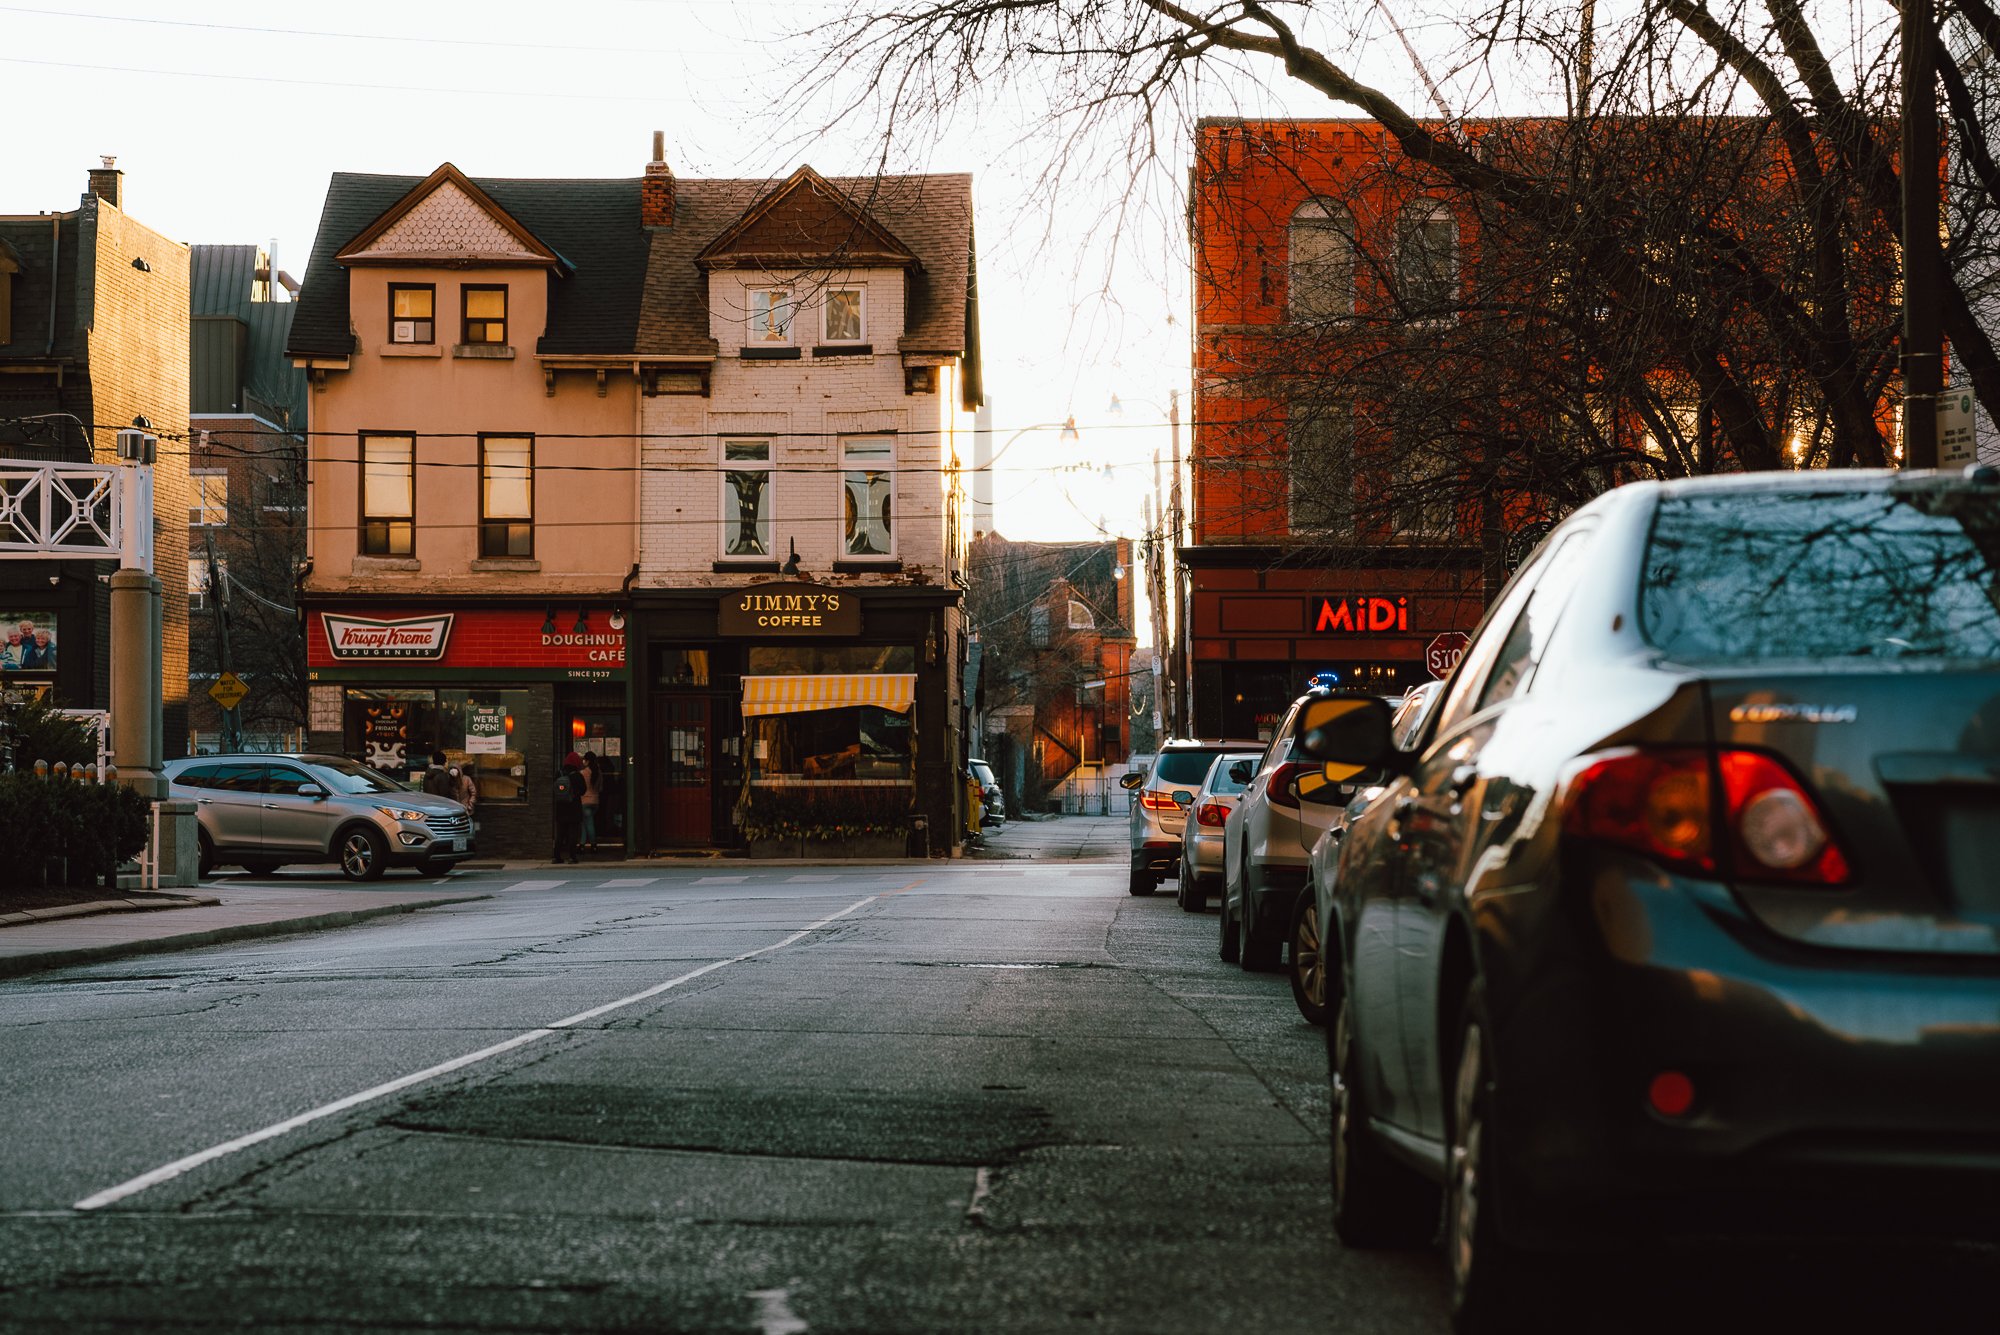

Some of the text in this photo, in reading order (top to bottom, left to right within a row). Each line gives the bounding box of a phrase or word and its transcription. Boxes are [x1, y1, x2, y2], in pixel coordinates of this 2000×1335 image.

[740, 594, 840, 611] JIMMY'S
[758, 616, 822, 626] COFFEE
[1315, 596, 1408, 631] MiDi
[340, 627, 435, 648] Krispy Kreme
[542, 634, 625, 646] DOUGHNUT
[589, 647, 626, 661] CAFÉ
[1431, 649, 1462, 669] STO
[473, 715, 499, 723] WE'RE
